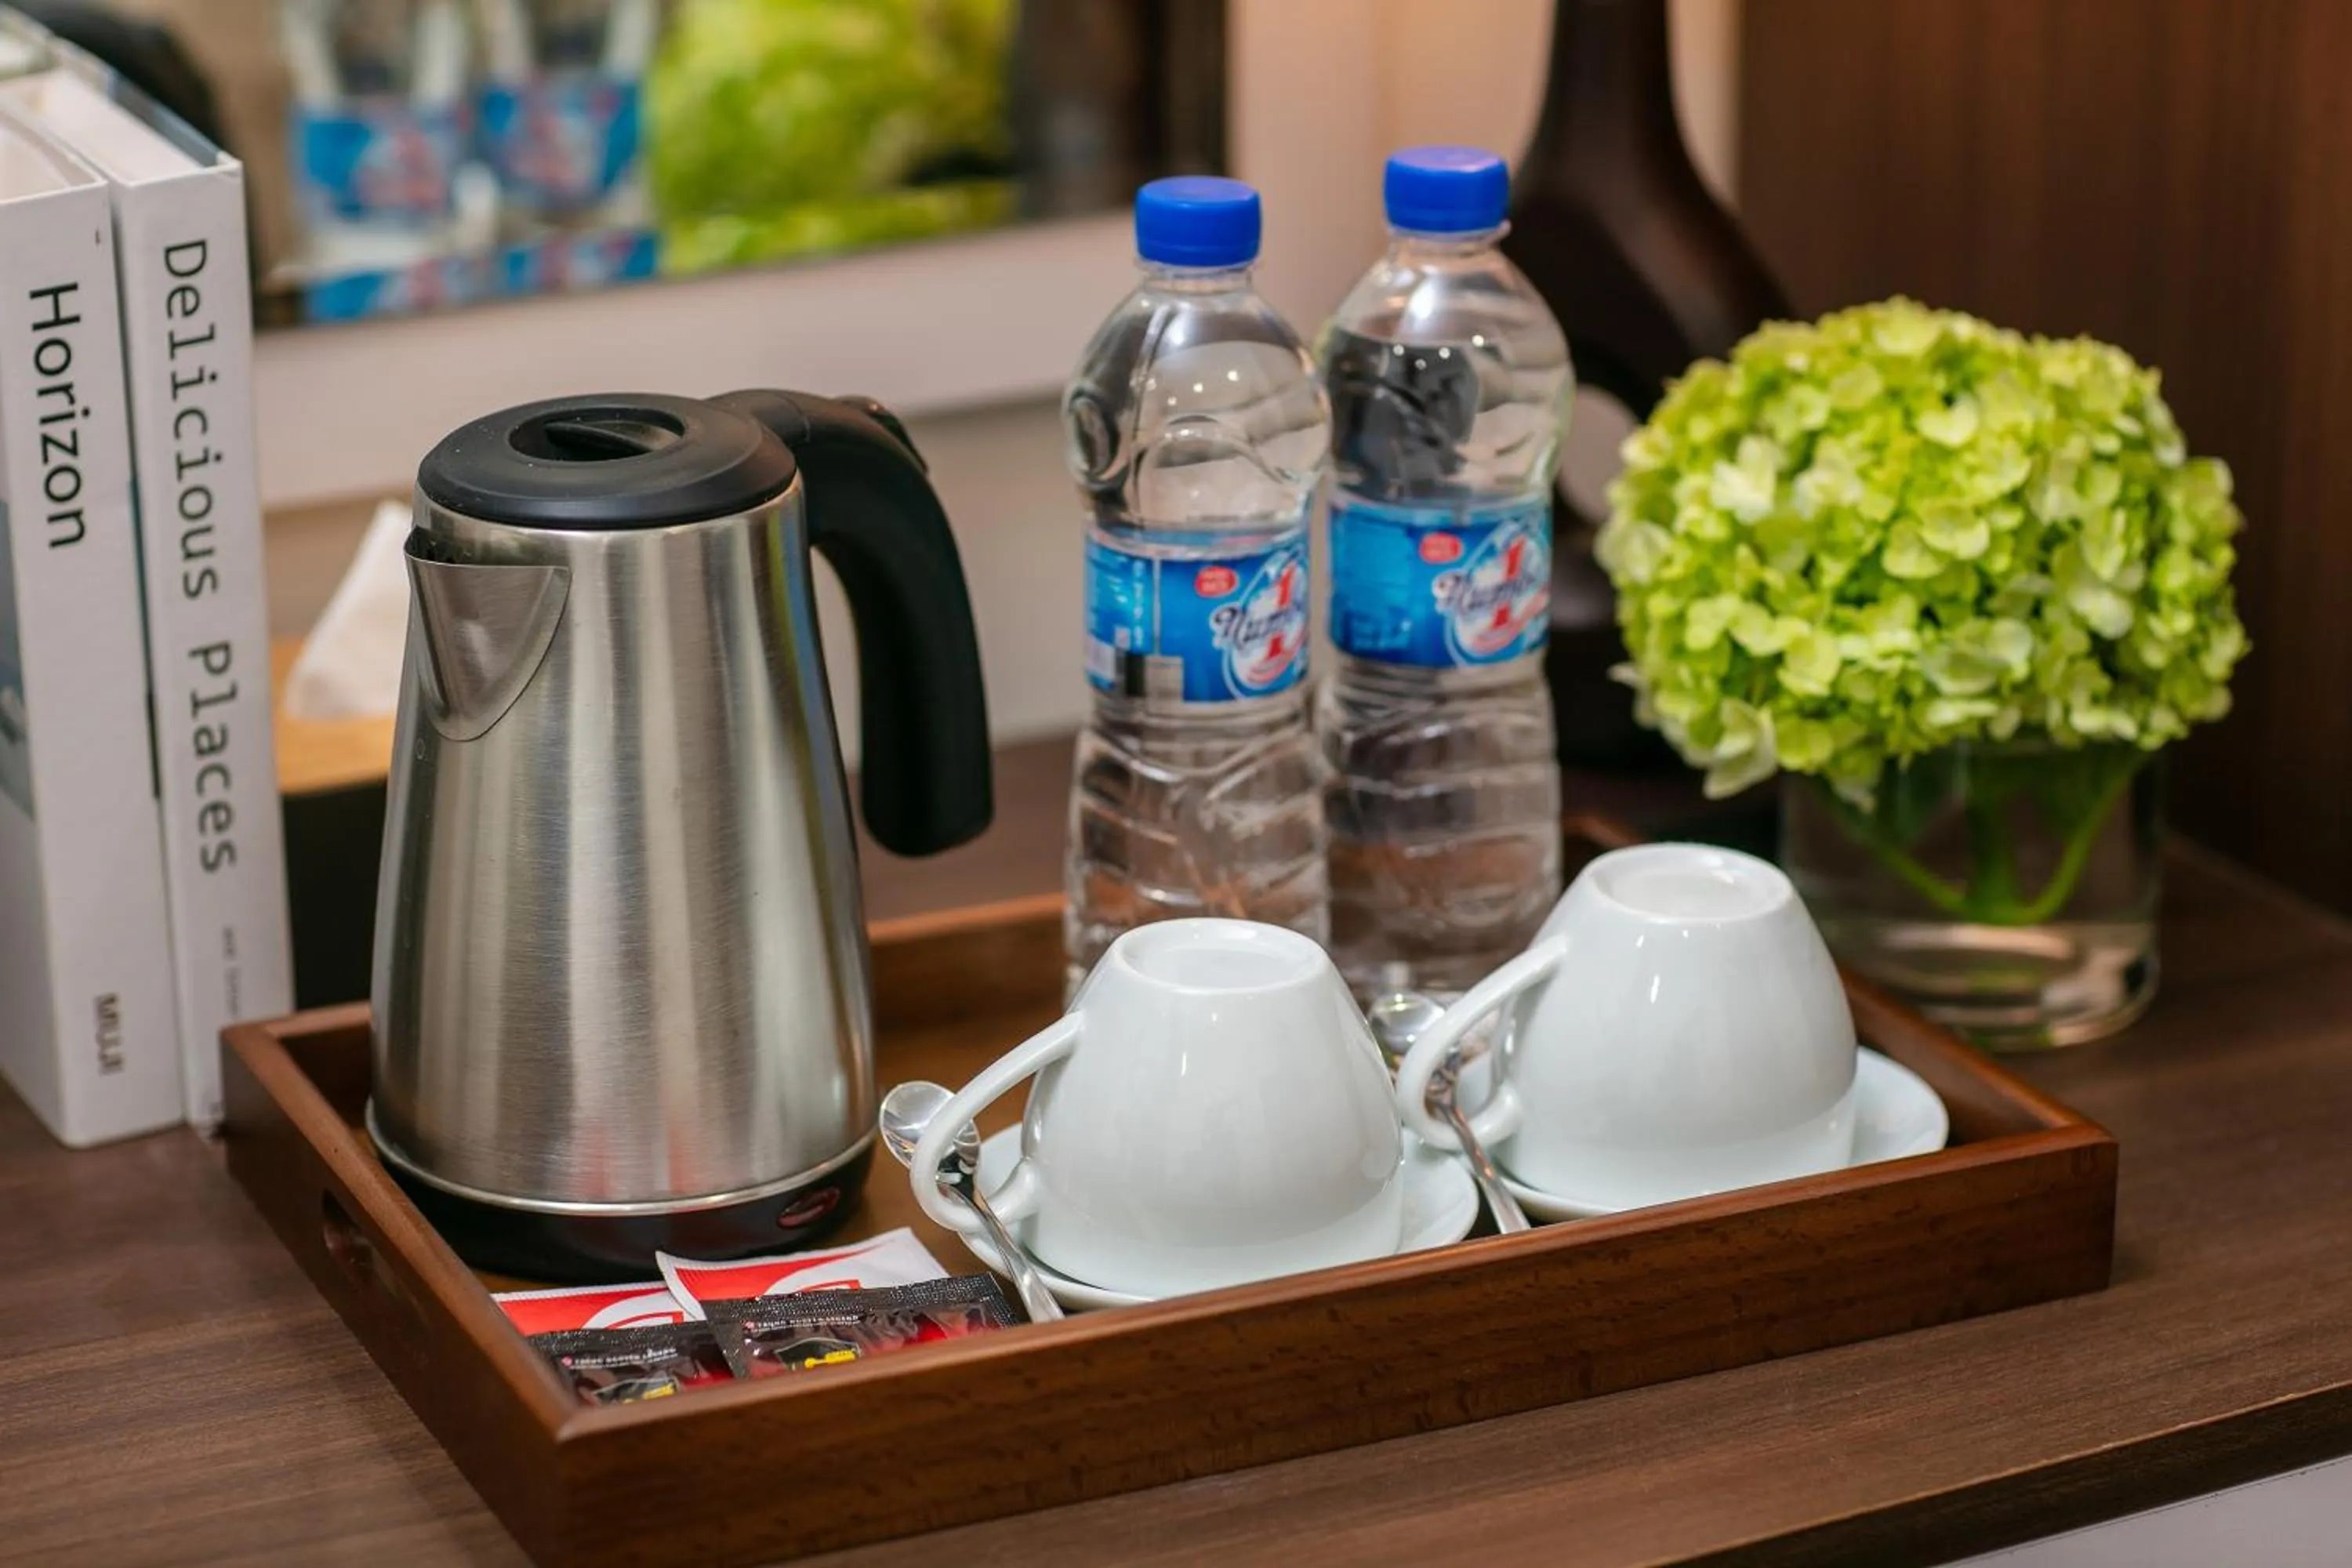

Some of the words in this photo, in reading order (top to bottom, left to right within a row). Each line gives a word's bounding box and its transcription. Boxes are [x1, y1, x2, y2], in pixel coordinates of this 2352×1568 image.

[28, 281, 91, 550] Horizon
[162, 238, 223, 601] Delicious
[187, 639, 239, 876] Places
